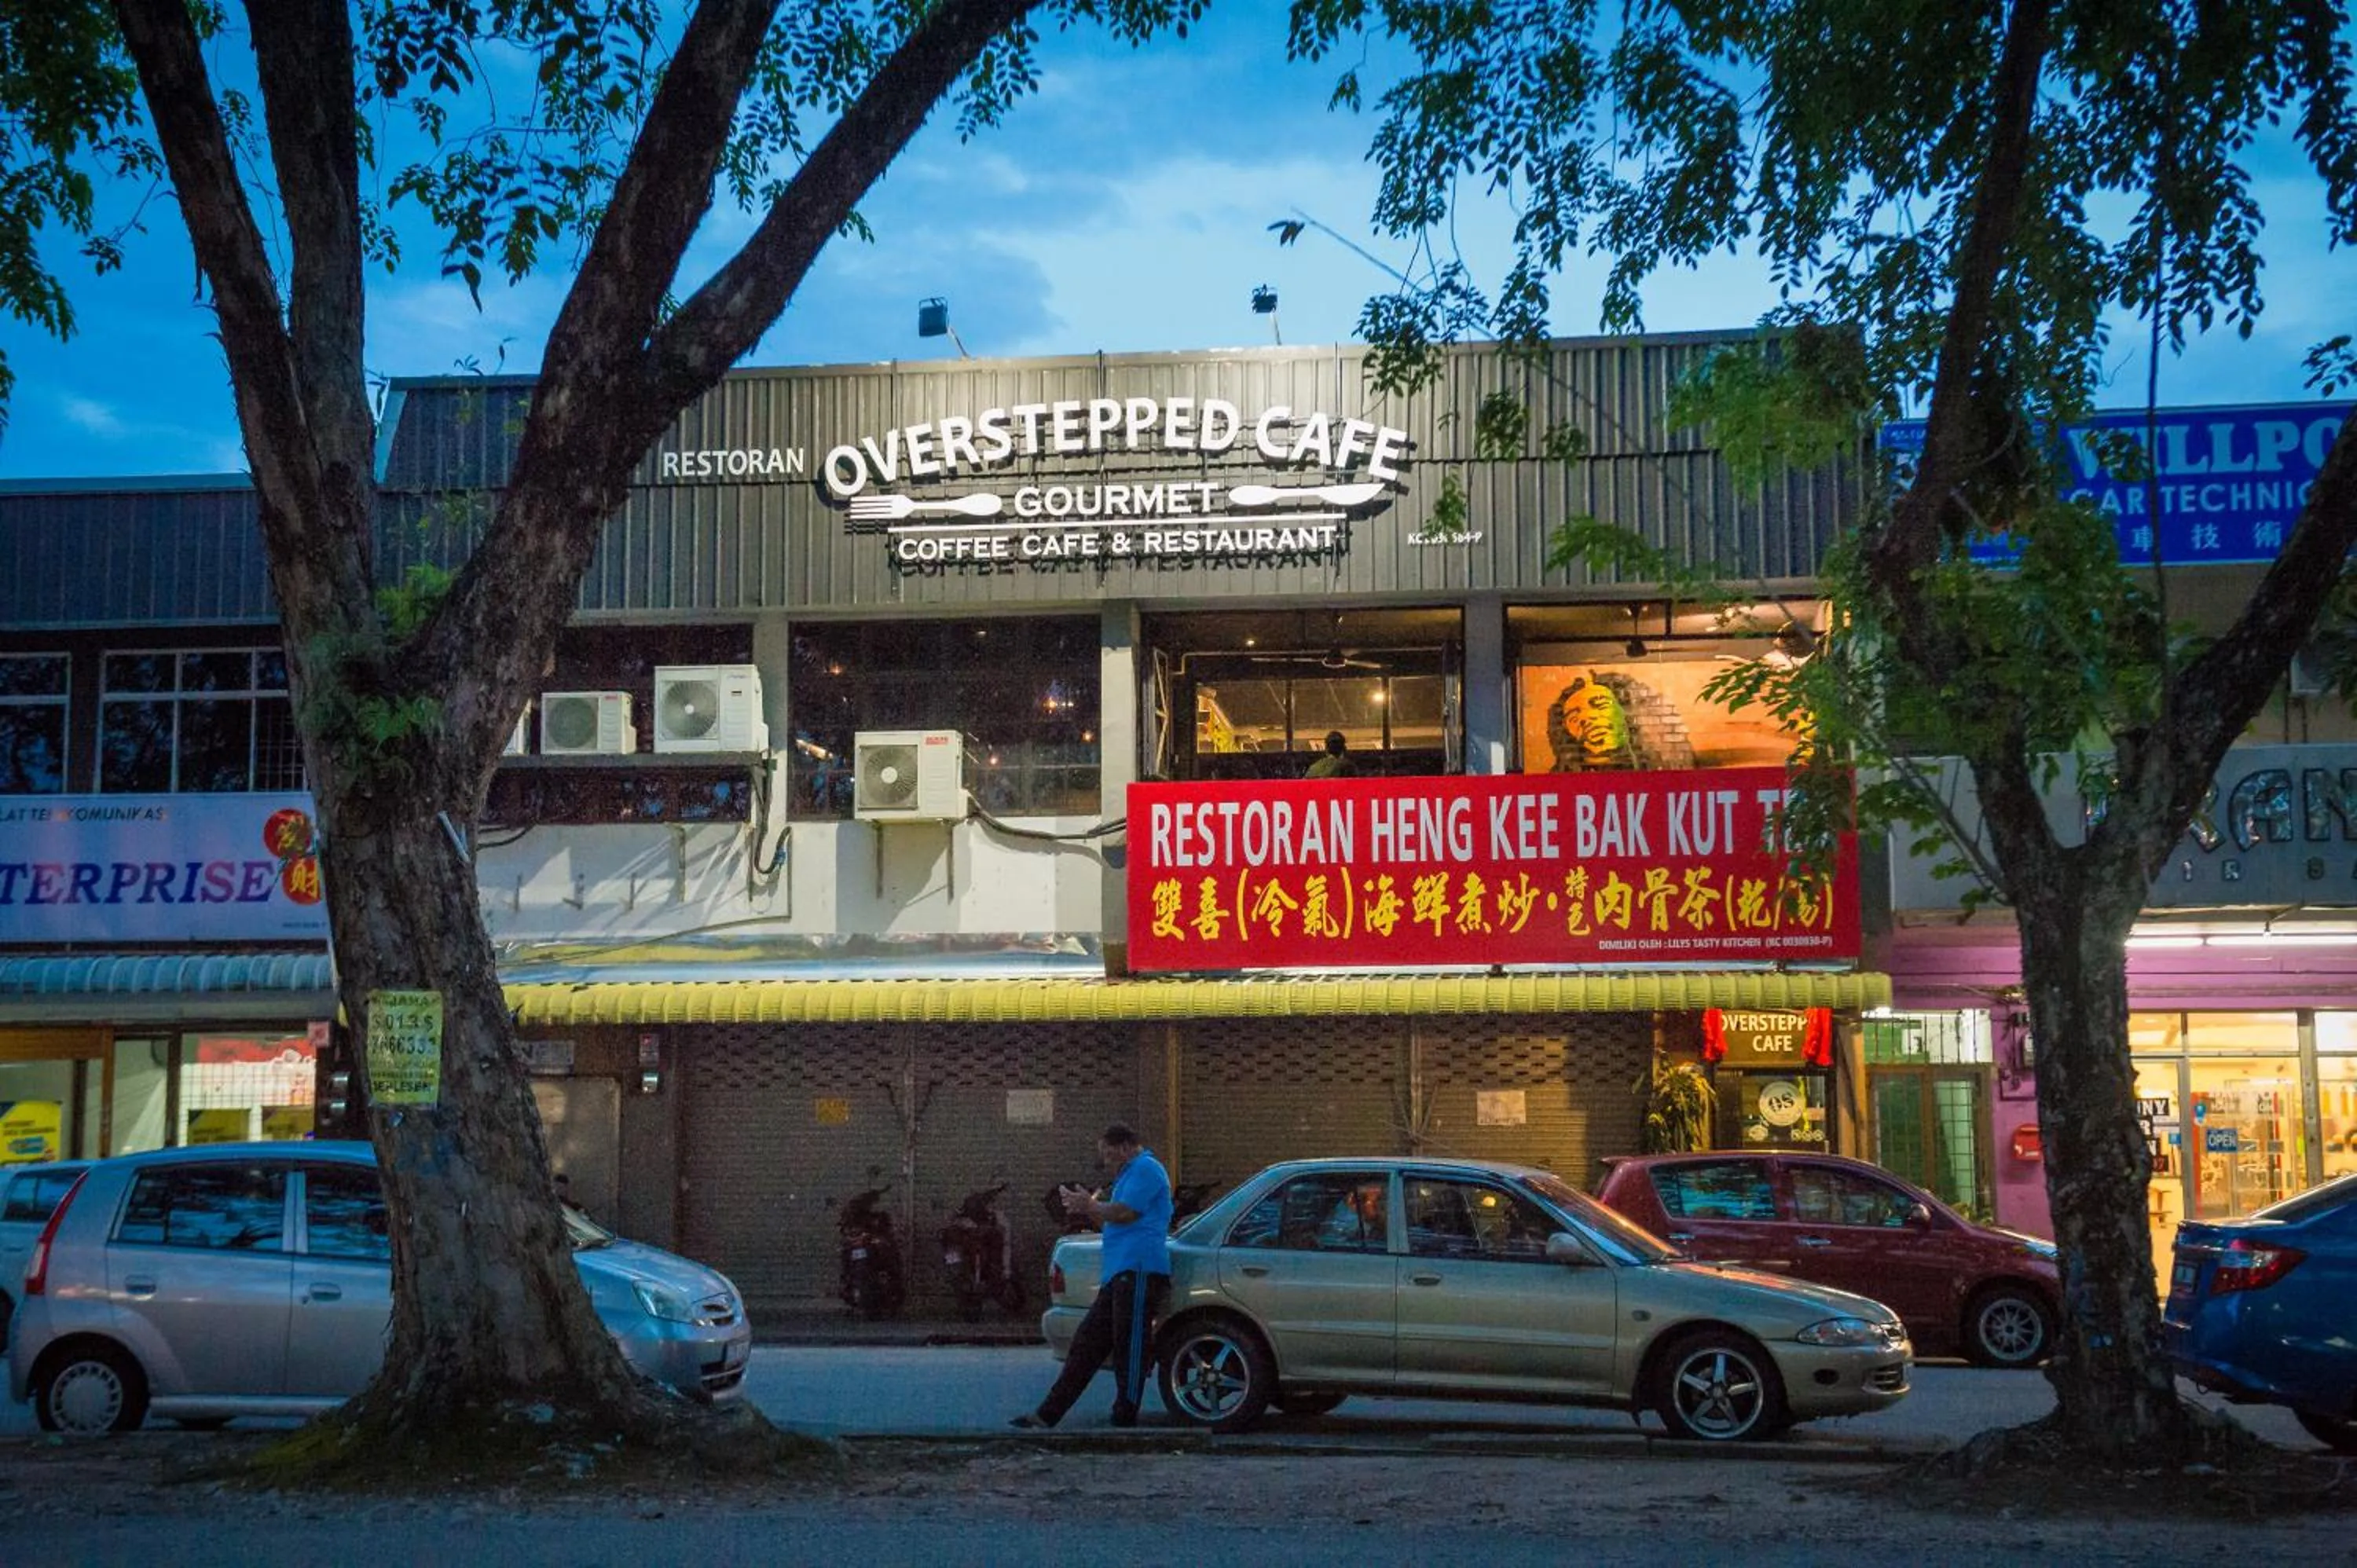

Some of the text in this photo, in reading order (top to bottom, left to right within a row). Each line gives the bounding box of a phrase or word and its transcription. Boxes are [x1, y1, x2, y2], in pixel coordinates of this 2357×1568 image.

[824, 397, 1407, 496] OVERSTEPPED CAFE
[662, 448, 805, 478] RESTORAN
[1014, 482, 1219, 517] GOURMET
[898, 526, 1337, 560] COFFEE CAFE & RESTAURANT
[1151, 798, 1354, 867] RESTORAN
[1371, 797, 1473, 863] HENG
[1489, 793, 1560, 859] KEE
[1576, 792, 1651, 858] BAK
[1667, 790, 1739, 855] KUT
[0, 861, 276, 906] TERPRISE
[1692, 938, 1721, 948] TASTY
[1721, 1014, 1809, 1032] OVERSTEPP
[1753, 1034, 1793, 1053] CAFE
[2208, 1133, 2237, 1147] OPEN
